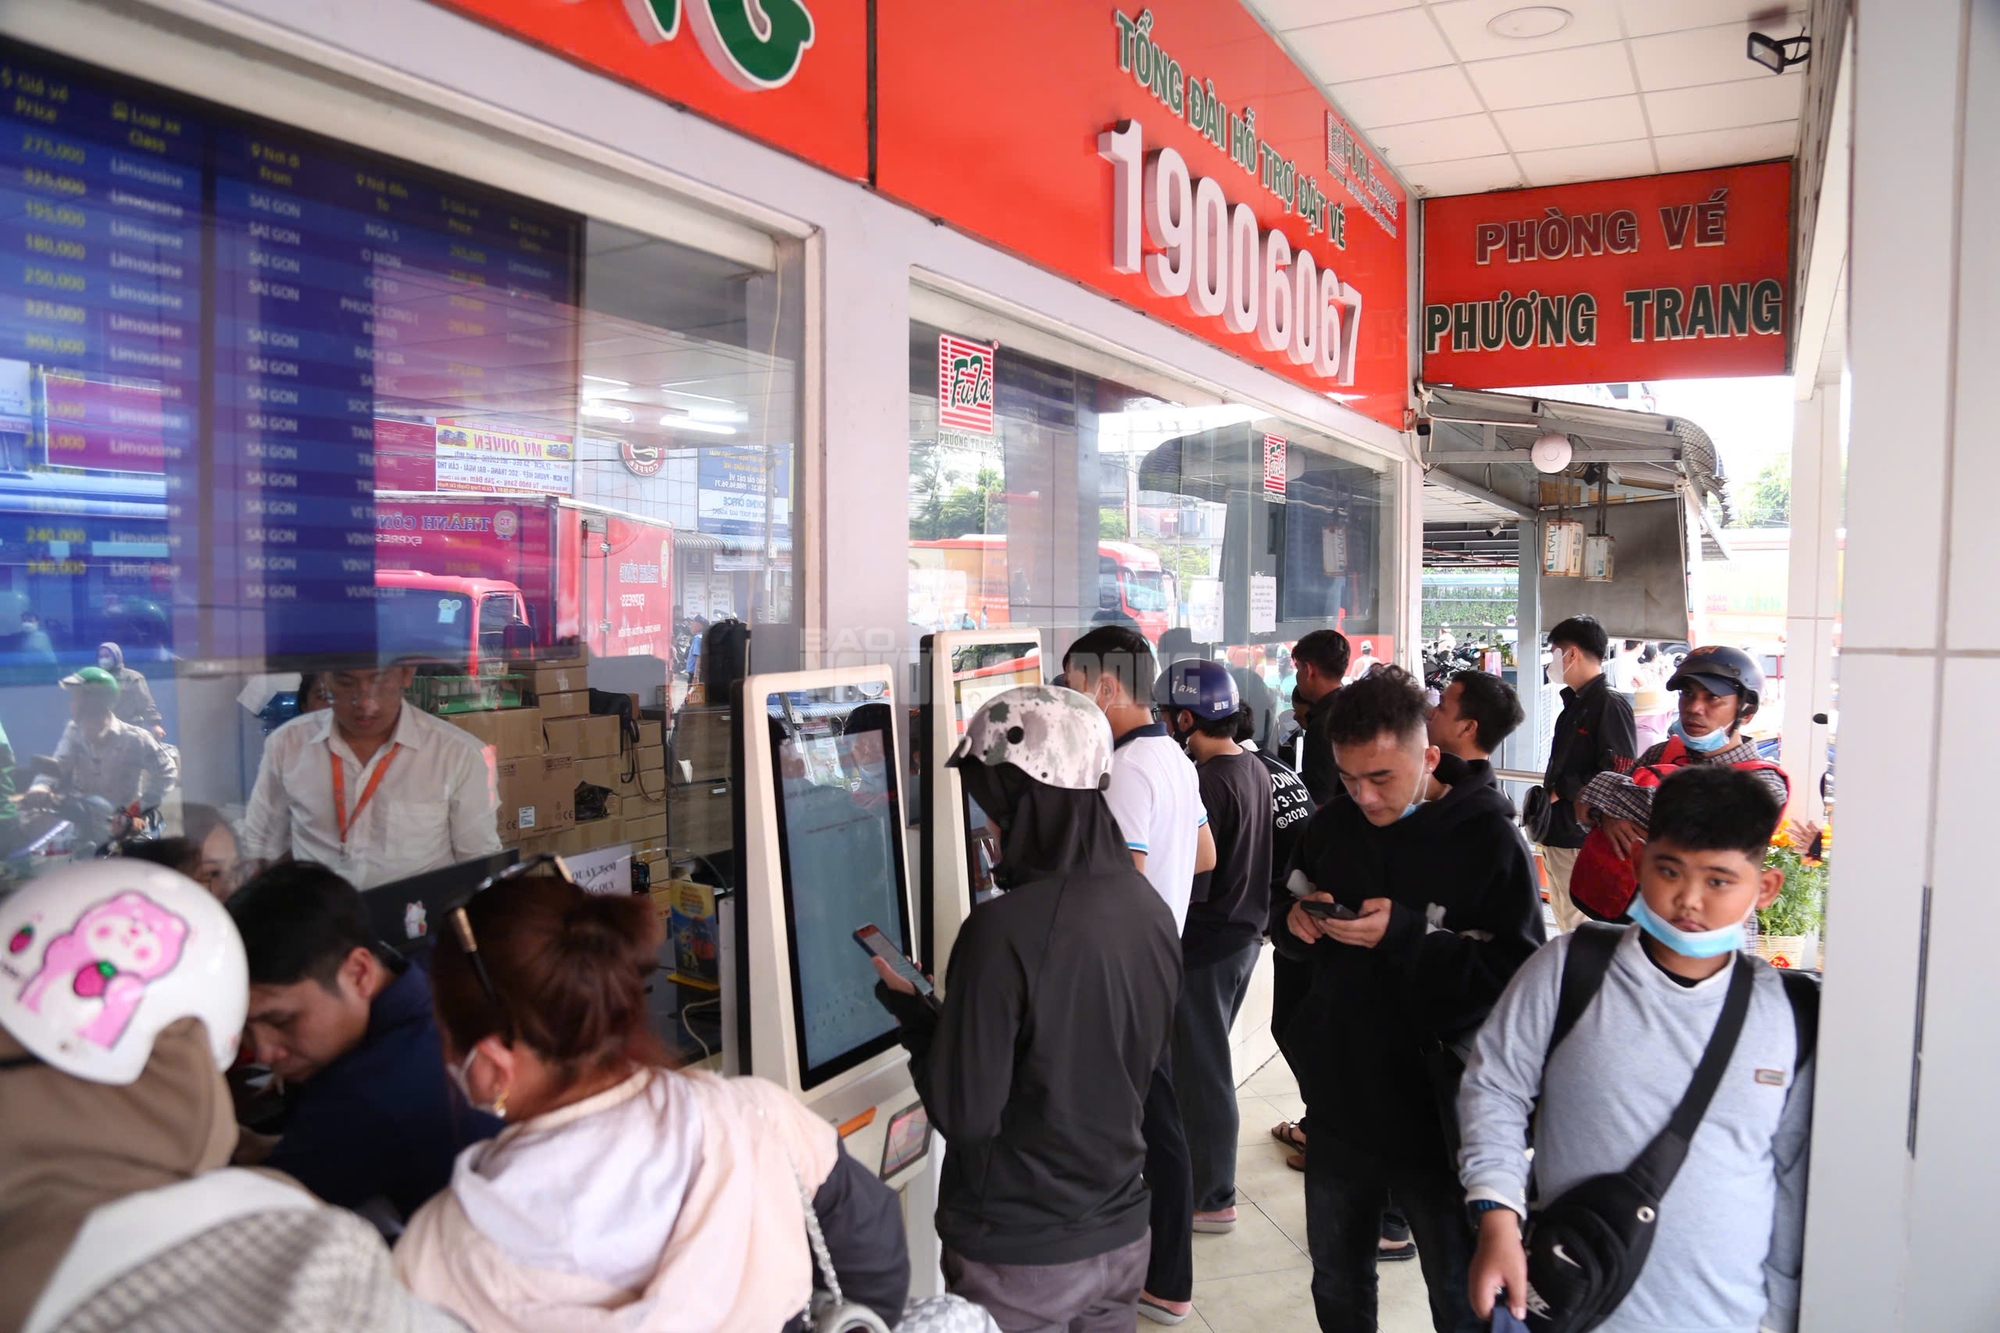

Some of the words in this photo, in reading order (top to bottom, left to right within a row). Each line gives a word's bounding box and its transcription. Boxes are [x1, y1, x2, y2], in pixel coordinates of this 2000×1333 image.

[15, 96, 57, 123] Price
[1114, 8, 1184, 119] TỔNG
[1188, 77, 1227, 153] ĐÀI
[1259, 139, 1297, 215] TRỢ
[1297, 171, 1327, 237] ĐẶT
[1327, 201, 1347, 250] VÉ
[111, 157, 183, 190] Limousine
[110, 189, 183, 219] Limousine
[110, 220, 183, 250] Limousine
[1475, 206, 1640, 266] PHÒNG
[1658, 187, 1729, 251] VÉ
[110, 251, 183, 280] Limousine
[1097, 118, 1363, 388] 19006067
[110, 283, 183, 310] Limousine
[110, 314, 183, 340] Limousine
[1424, 289, 1598, 354] PHƯƠNG
[1623, 278, 1783, 344] TRANG
[110, 345, 183, 370] Limousine
[109, 438, 182, 460] Limousine
